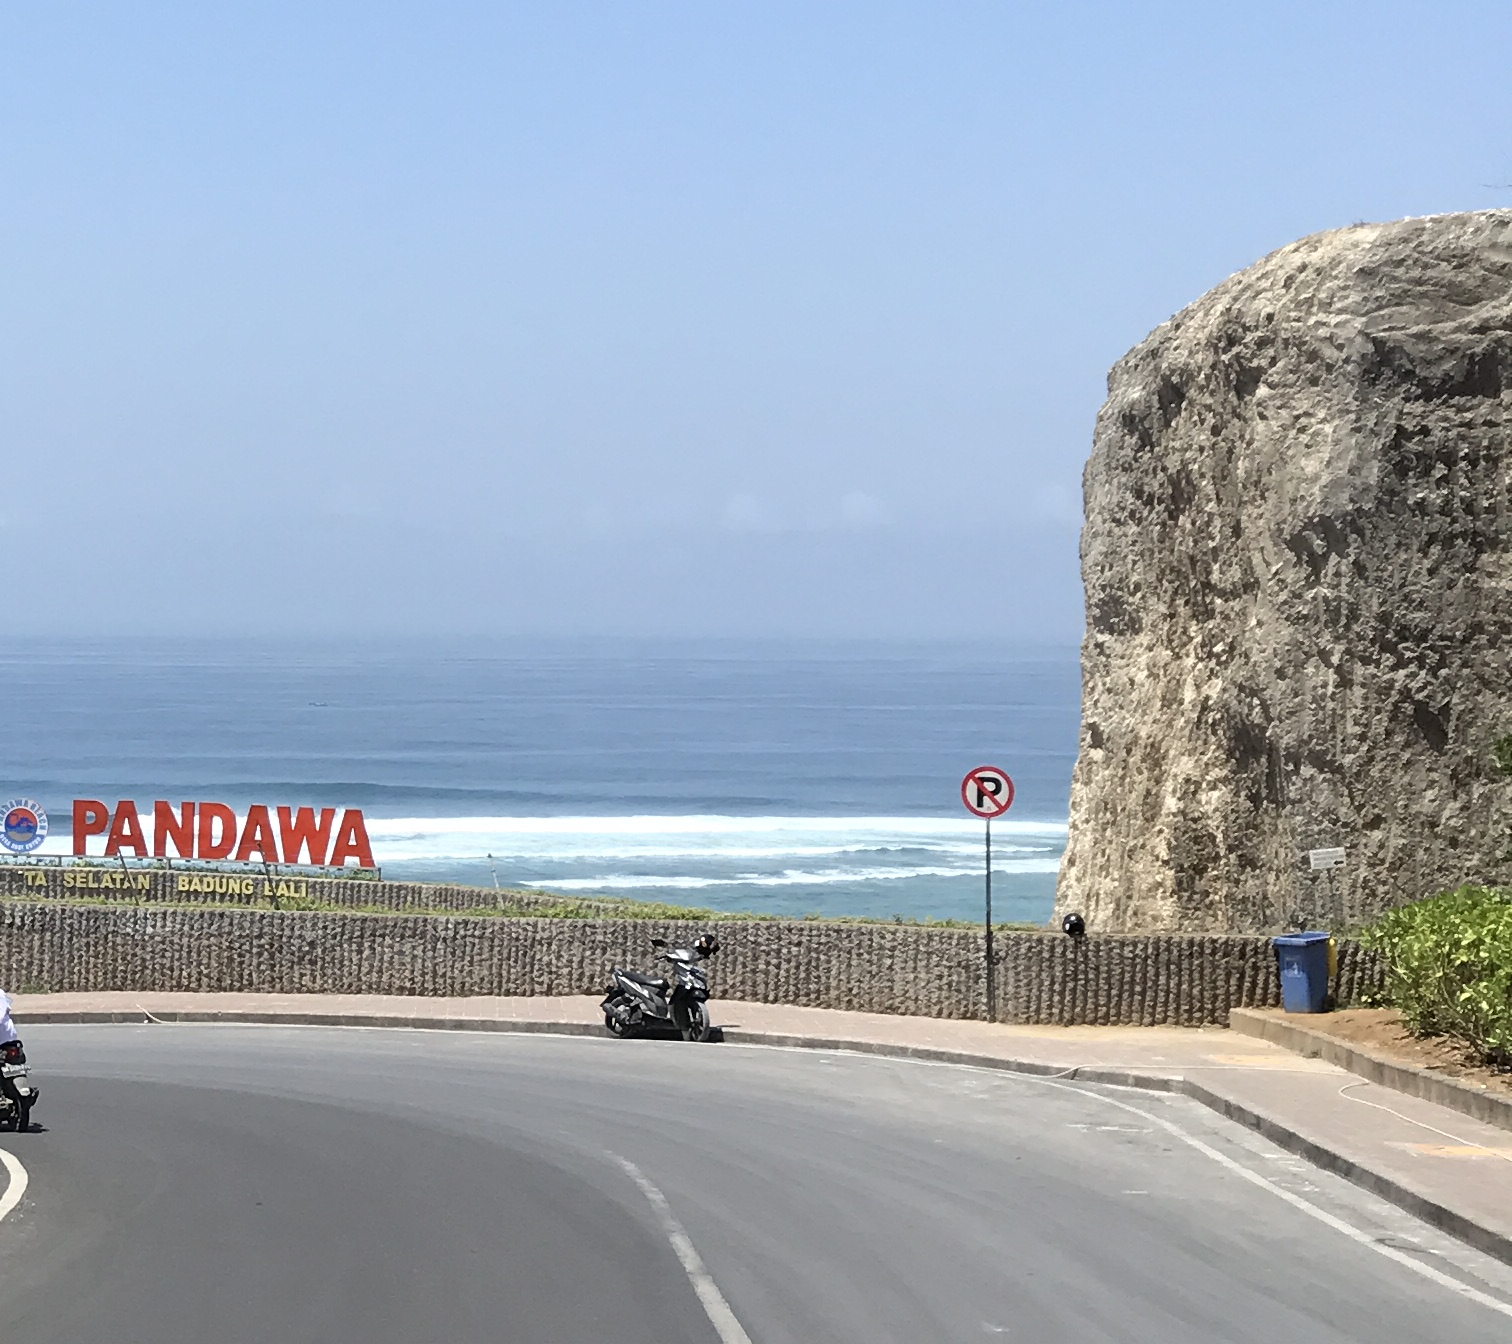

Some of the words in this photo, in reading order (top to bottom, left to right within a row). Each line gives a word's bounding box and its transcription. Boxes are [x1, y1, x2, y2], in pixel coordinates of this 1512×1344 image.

[72, 799, 376, 868] PANDAWA
[62, 871, 150, 890] SELATAN
[178, 876, 254, 895] BADUNG
